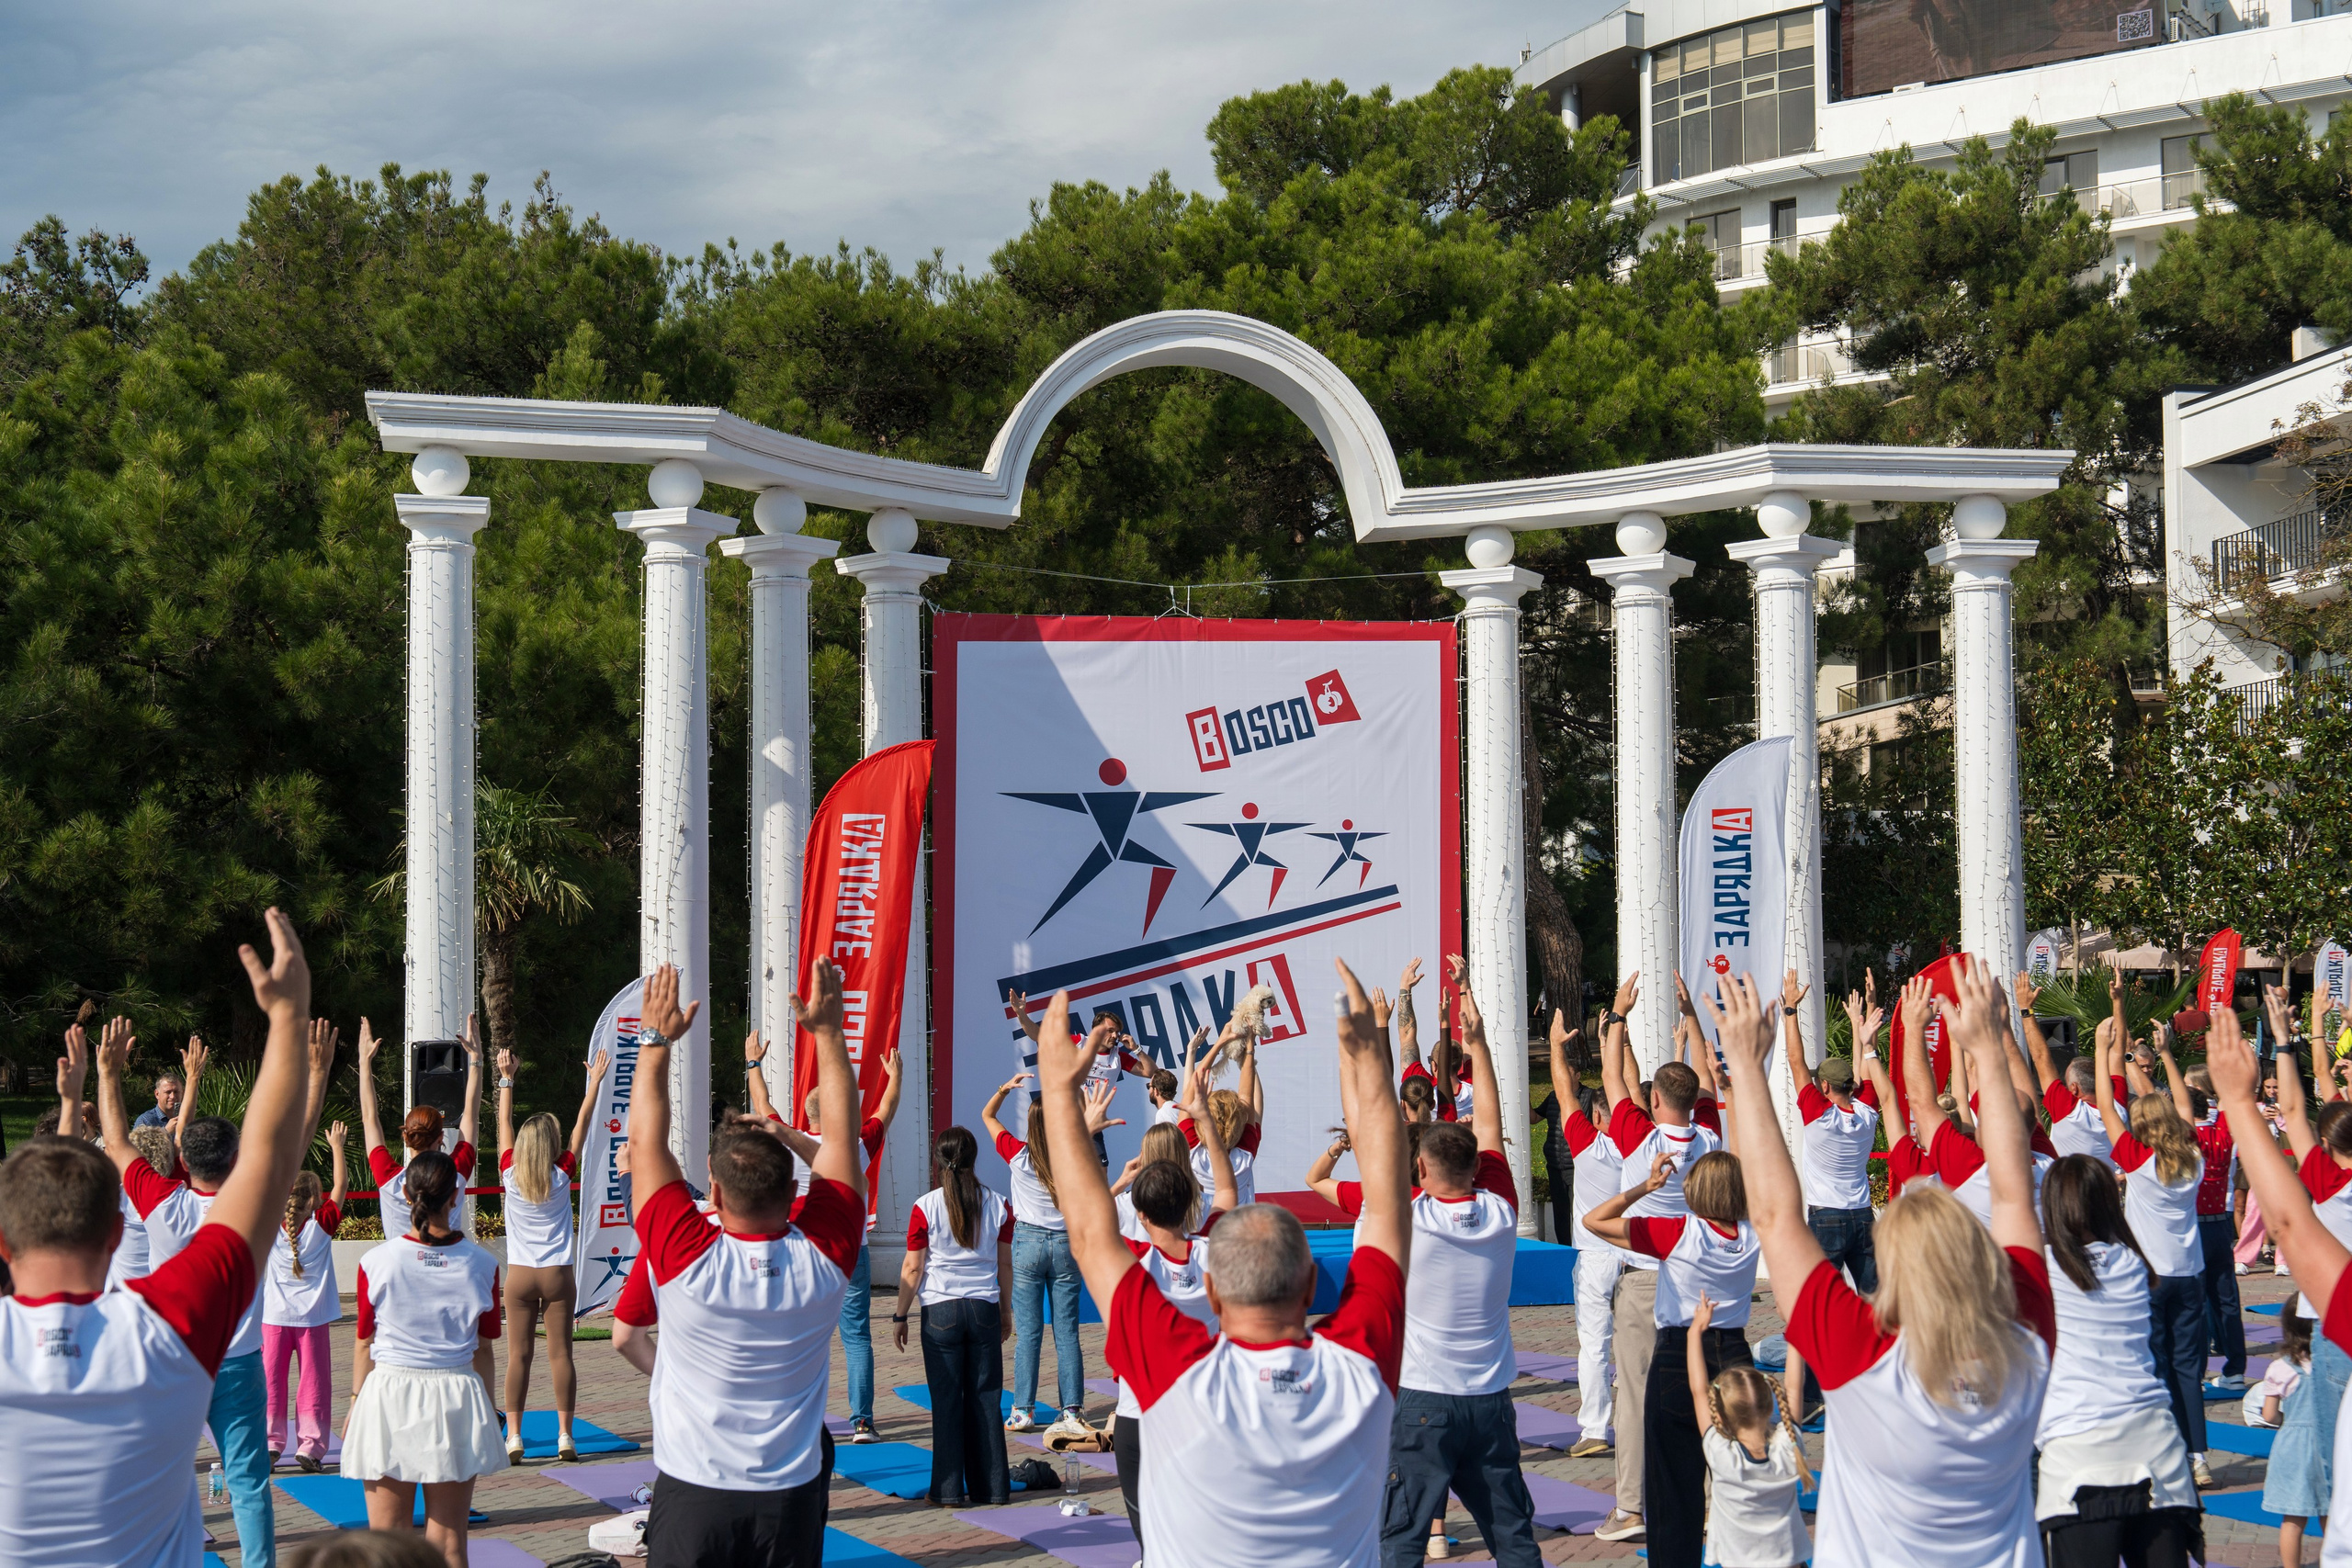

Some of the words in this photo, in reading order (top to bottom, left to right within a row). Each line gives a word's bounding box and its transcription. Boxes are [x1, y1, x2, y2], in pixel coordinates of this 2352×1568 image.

[1186, 695, 1316, 773] BOSCO
[833, 814, 886, 959] ЗАРЯДКА
[1712, 808, 1752, 947] ЗАРЯДКА
[2036, 945, 2049, 975] РЯДКА
[2211, 947, 2228, 992] ЗАРЯДКА
[2328, 951, 2344, 999] ЗАРЯДКА
[1012, 953, 1307, 1102] ЯДКА
